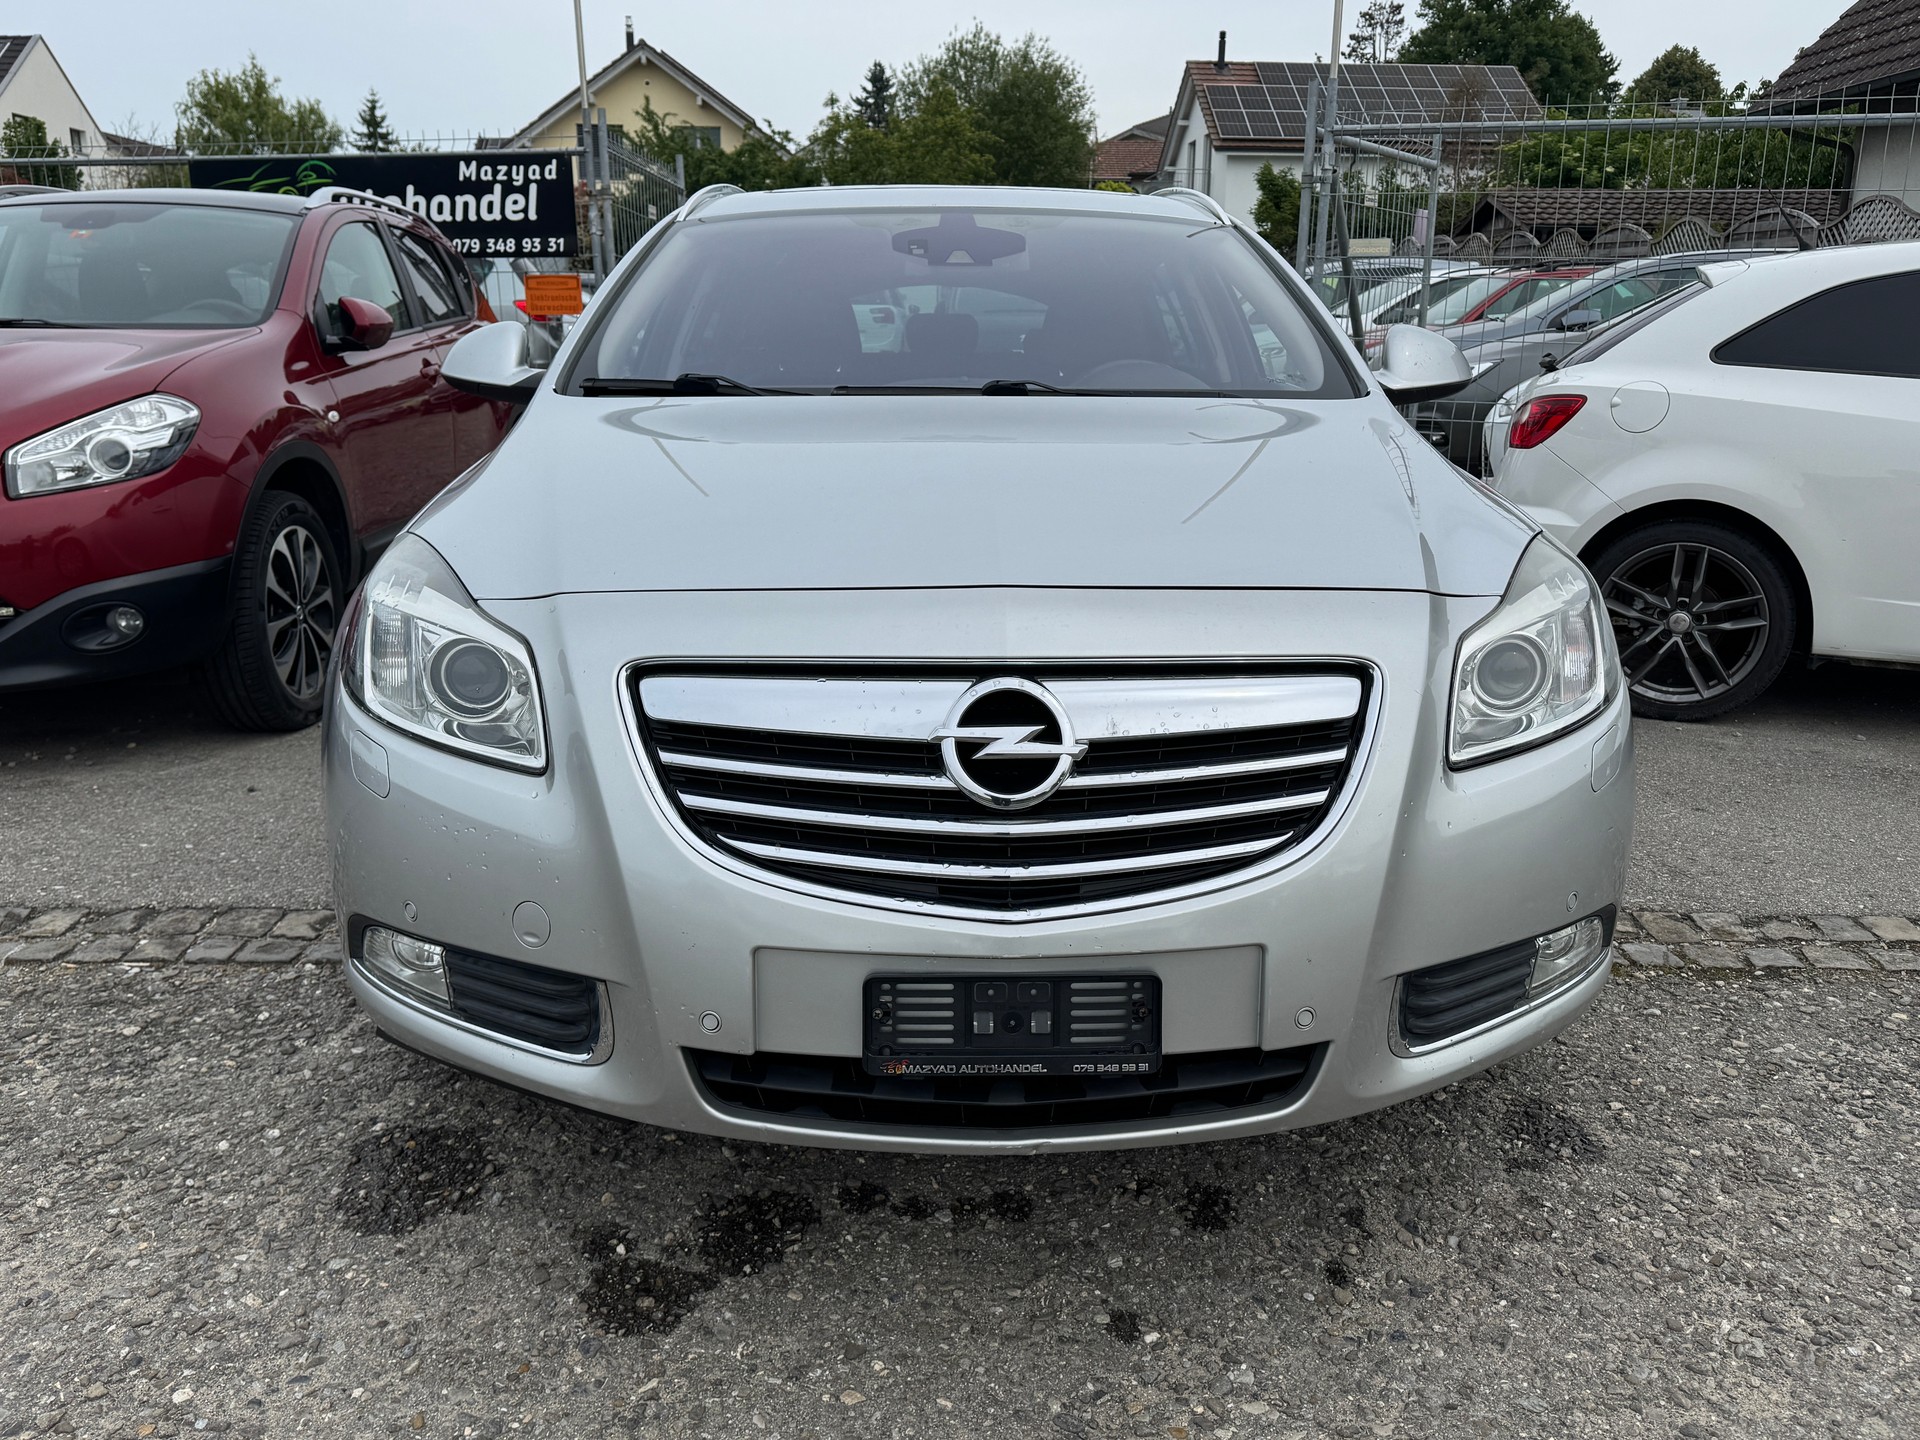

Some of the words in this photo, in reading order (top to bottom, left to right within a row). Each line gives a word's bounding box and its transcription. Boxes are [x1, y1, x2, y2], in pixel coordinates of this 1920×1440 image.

[458, 159, 558, 187] Mazyad
[339, 184, 539, 223] handel
[452, 238, 481, 254] 079
[485, 238, 516, 253] 348
[521, 237, 542, 253] 93
[547, 237, 565, 253] 31
[969, 680, 1051, 699] OPEL
[902, 1064, 957, 1075] MAZYAD
[958, 1063, 1048, 1075] AUTOHANDEL
[1072, 1064, 1095, 1072] 079
[1096, 1064, 1120, 1072] 348
[1121, 1063, 1136, 1072] 93
[1138, 1062, 1149, 1072] 31
